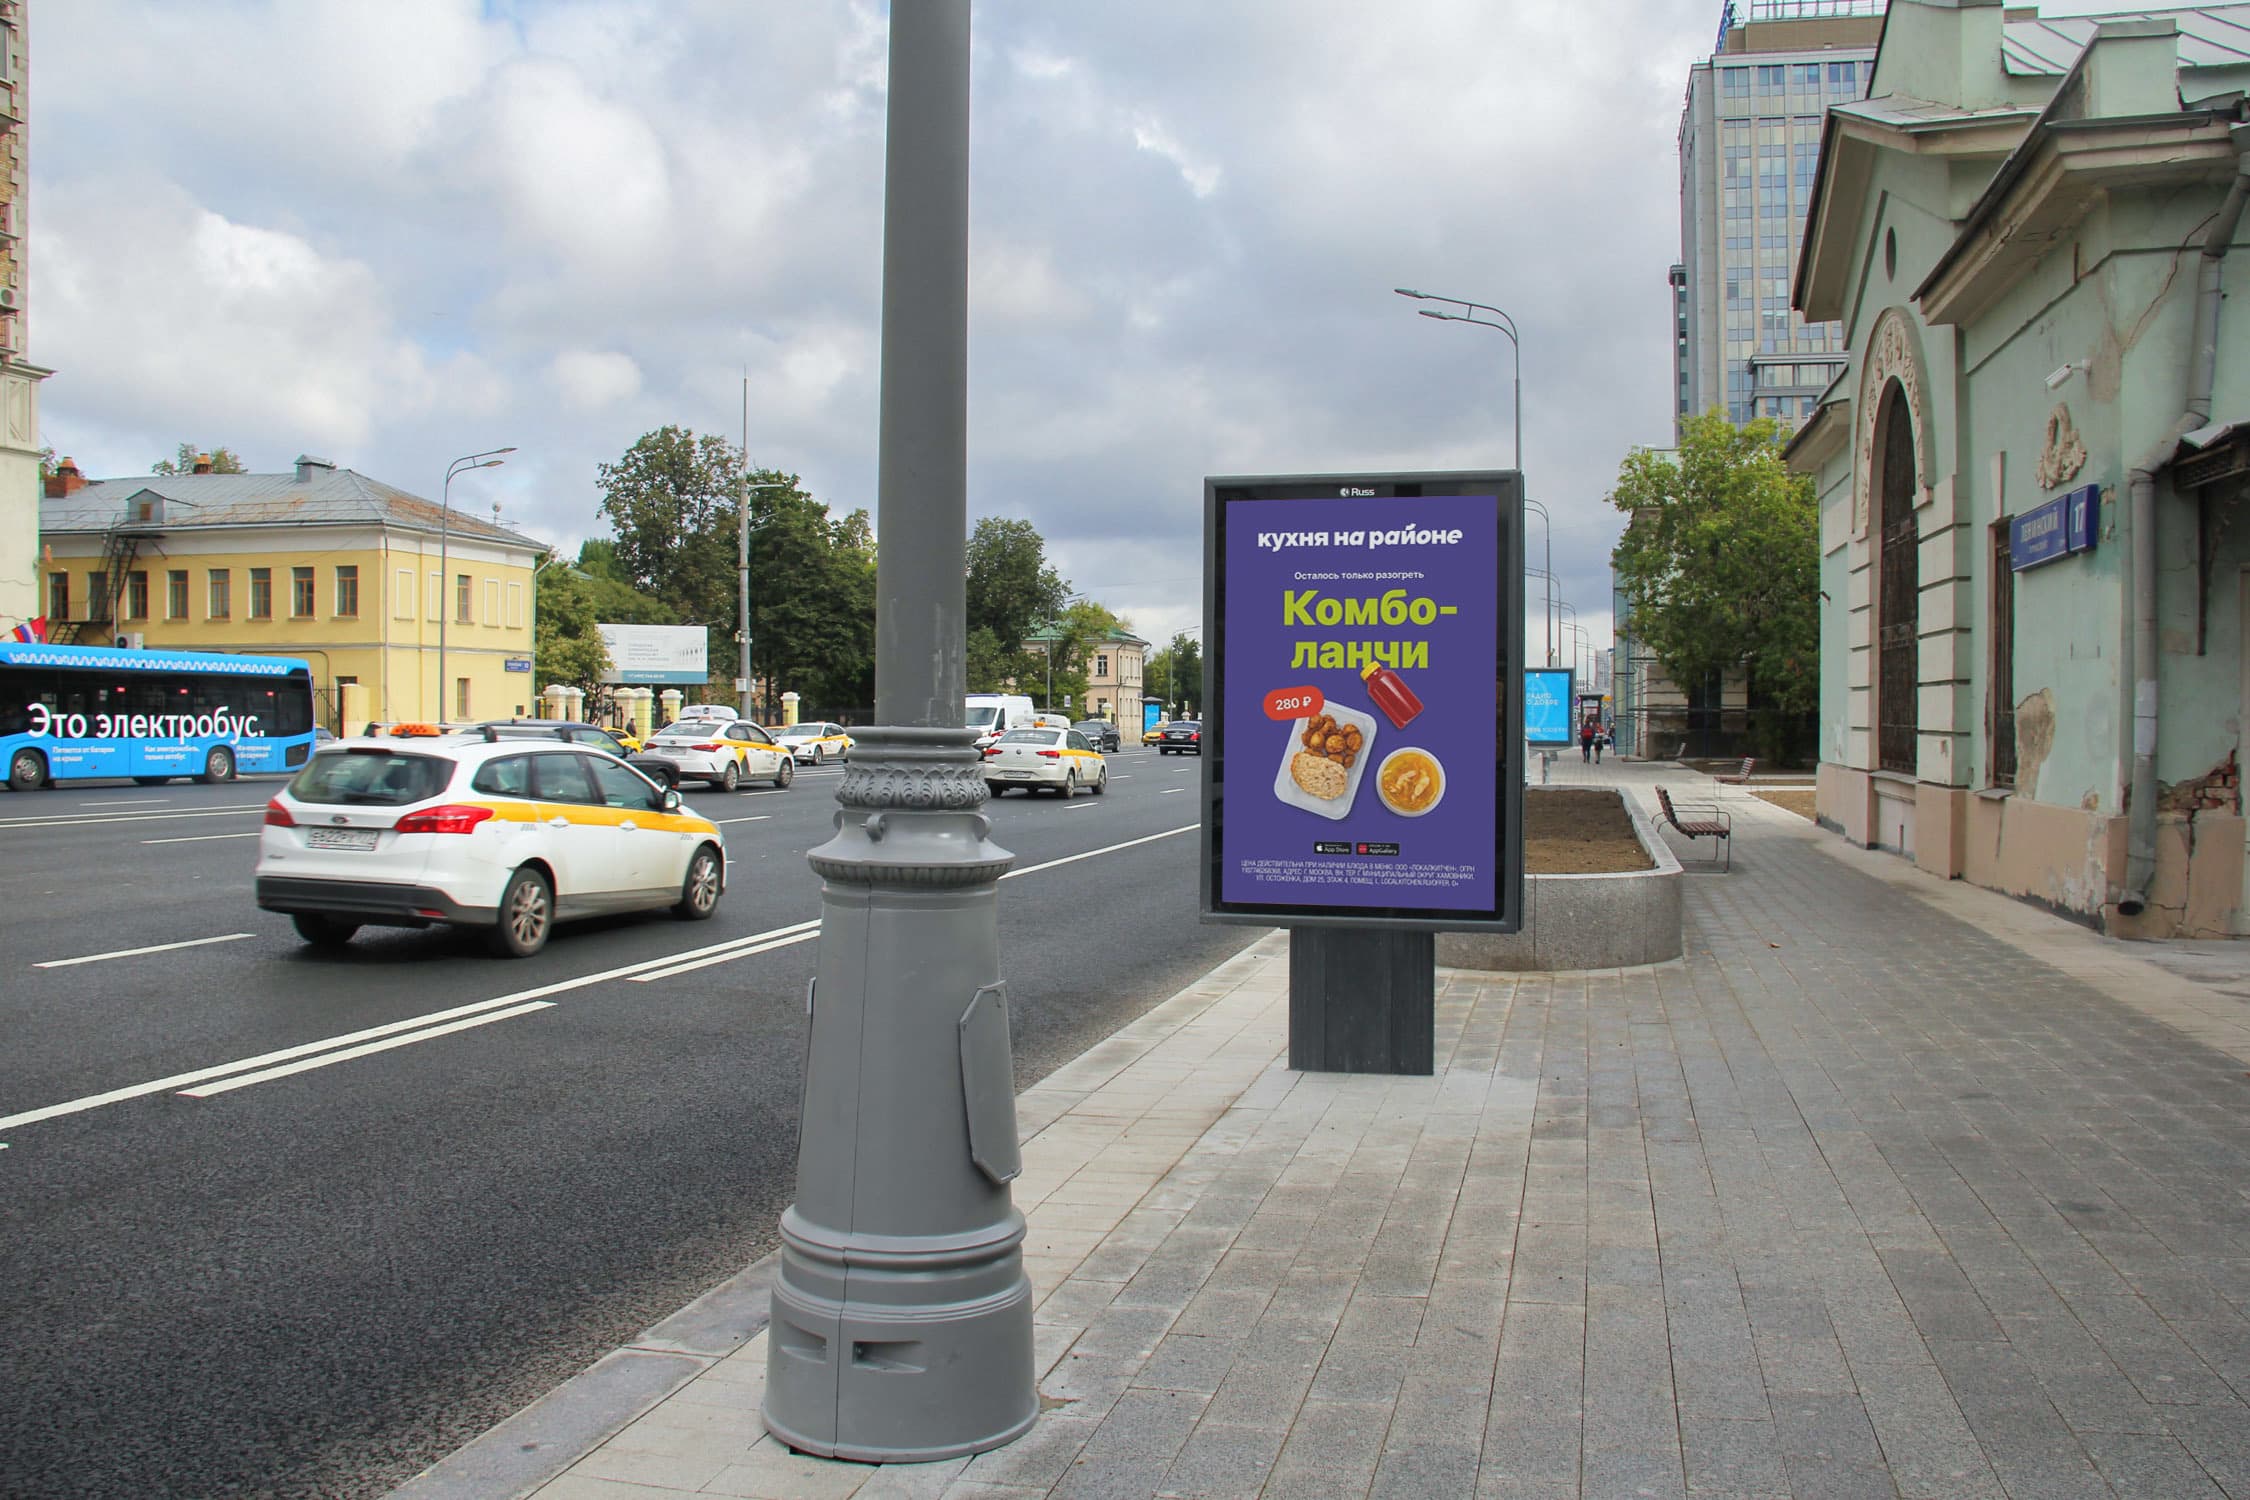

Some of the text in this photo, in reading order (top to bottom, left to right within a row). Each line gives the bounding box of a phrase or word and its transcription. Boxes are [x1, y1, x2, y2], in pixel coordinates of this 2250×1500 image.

[1351, 487, 1376, 497] Russ
[2074, 501, 2086, 534] 17
[1258, 523, 1464, 553] кухня на районе
[1294, 571, 1425, 581] Осталось только разогреть
[1283, 588, 1458, 627] Комбо-
[1290, 640, 1430, 670] ланчи
[1275, 697, 1301, 711] 280
[27, 703, 265, 746] Это электробус.
